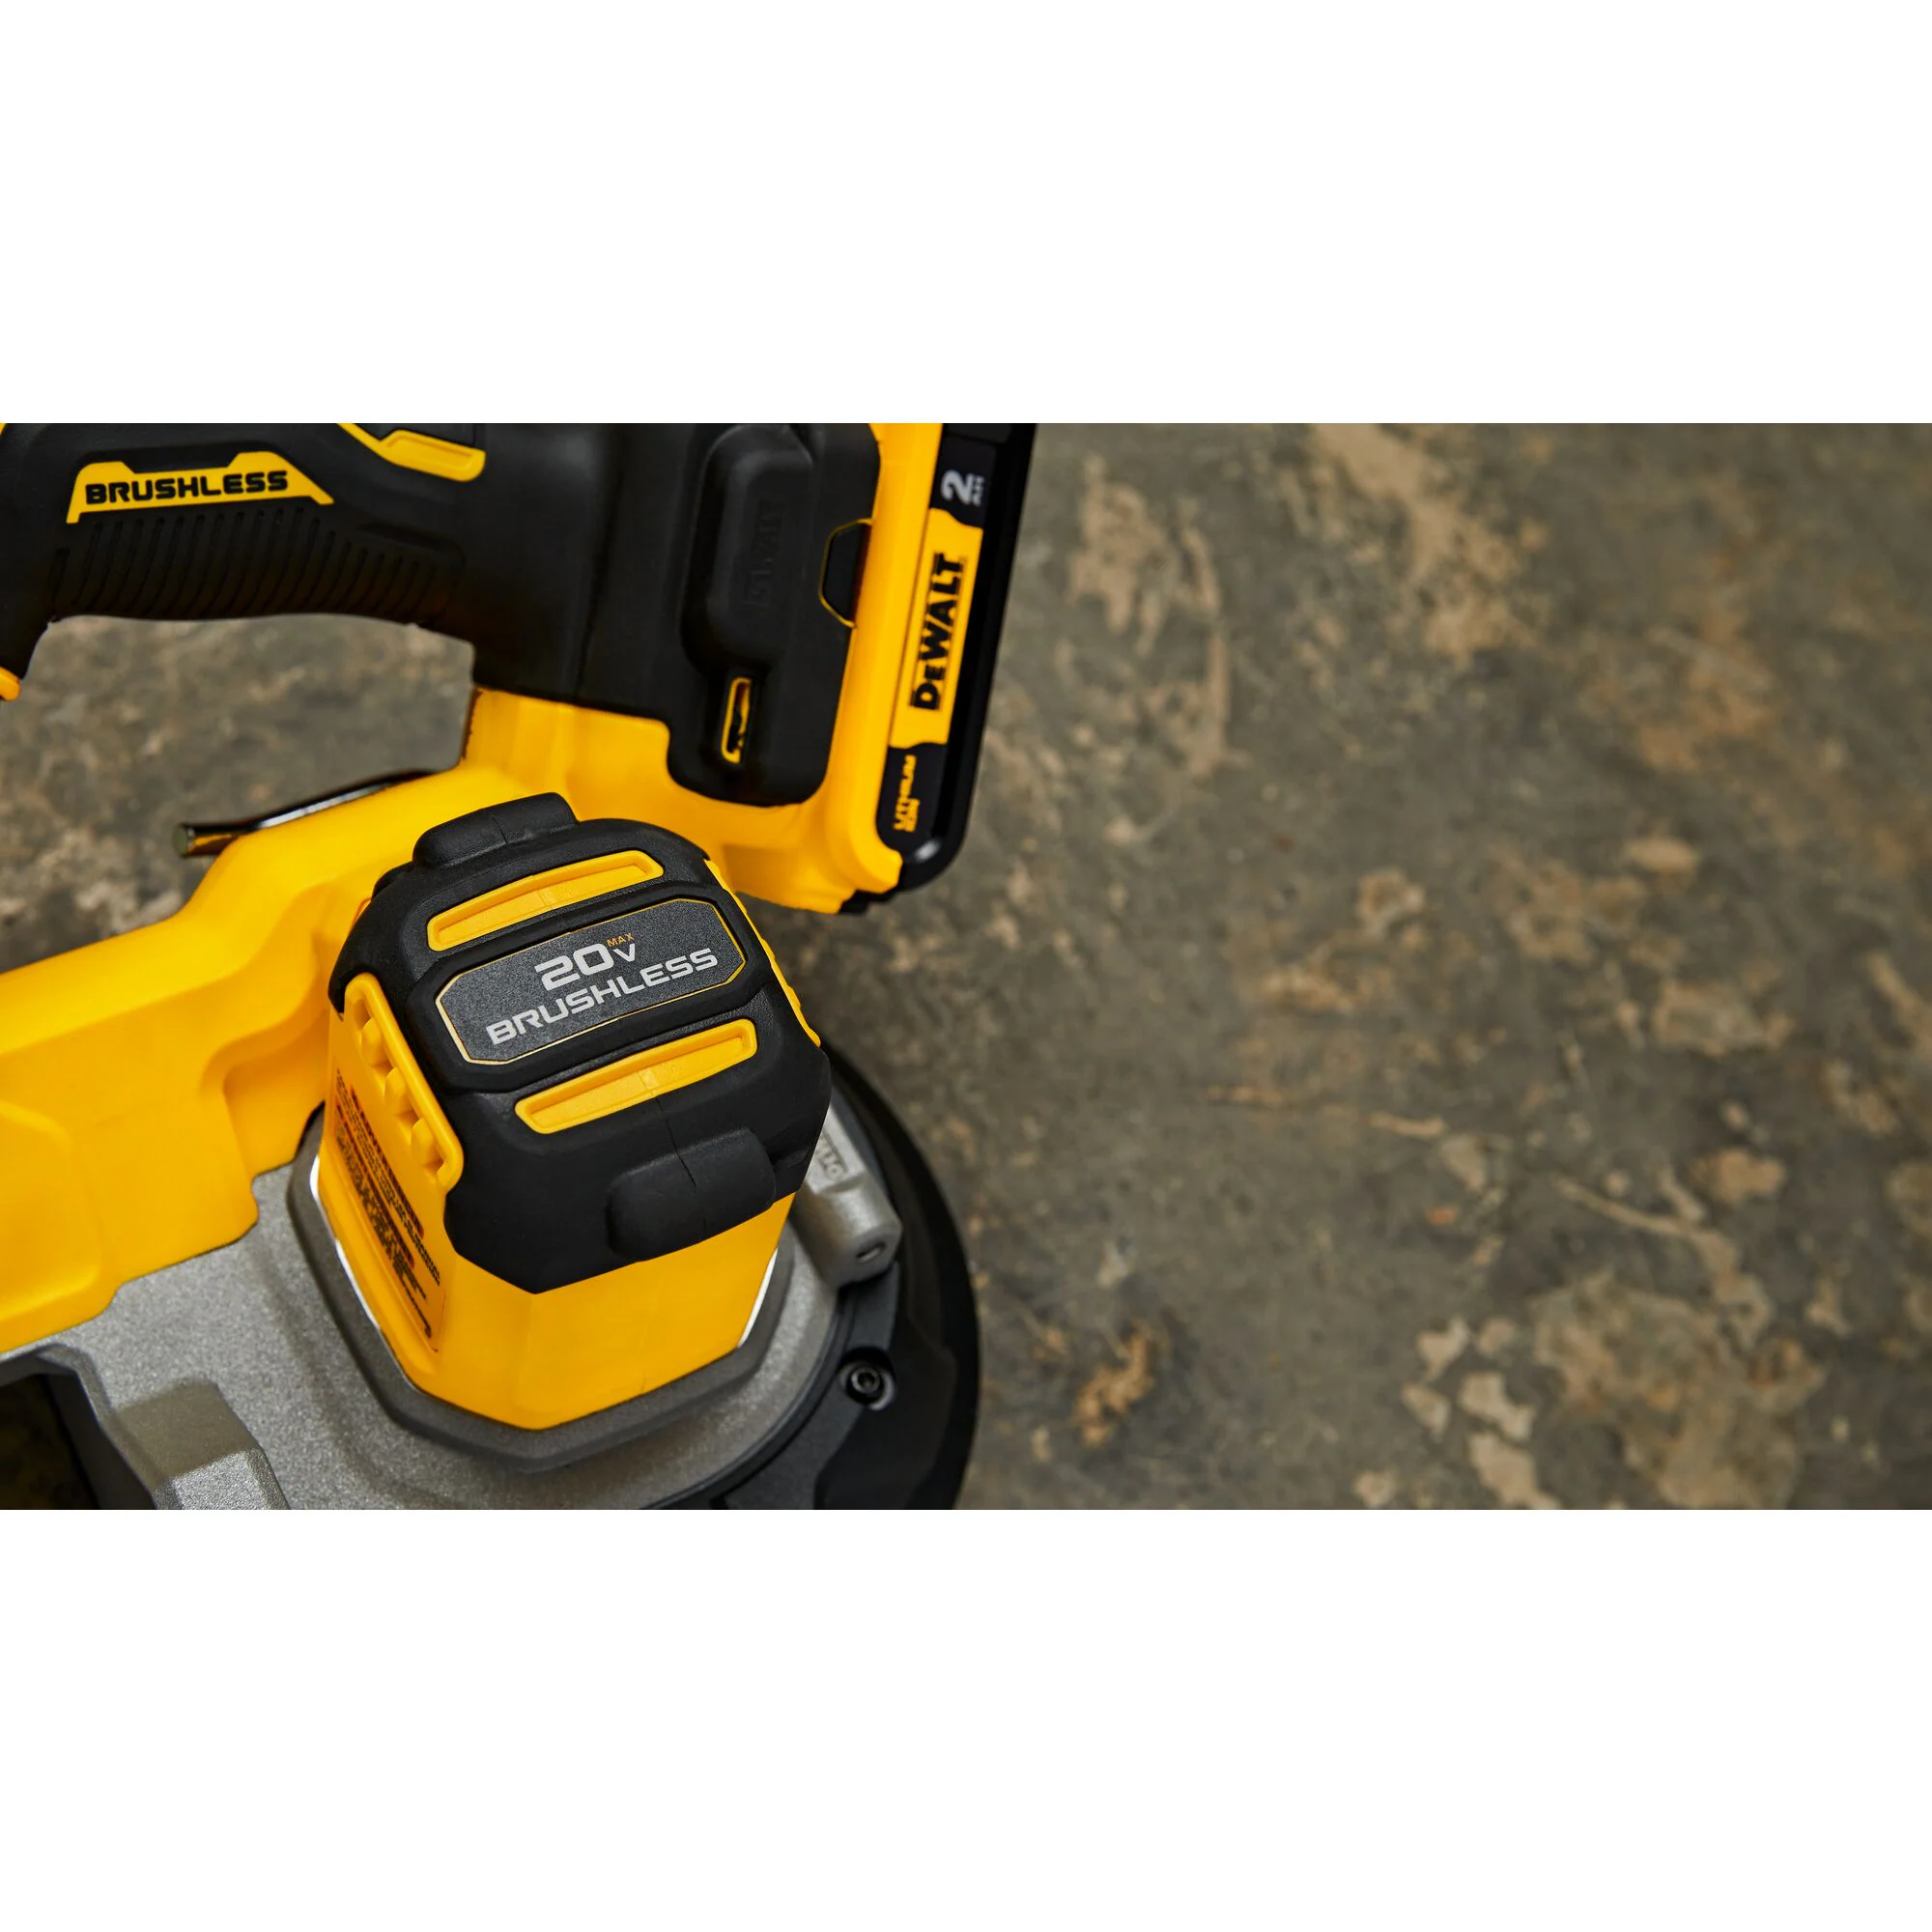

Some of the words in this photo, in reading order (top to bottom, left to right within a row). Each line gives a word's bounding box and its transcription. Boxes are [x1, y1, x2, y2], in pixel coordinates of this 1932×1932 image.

[85, 470, 288, 505] BRUSHLESS
[941, 469, 971, 505] 2
[910, 552, 964, 711] DEWALT
[607, 932, 635, 948] MAX
[486, 948, 718, 1045] BRUSHLESS
